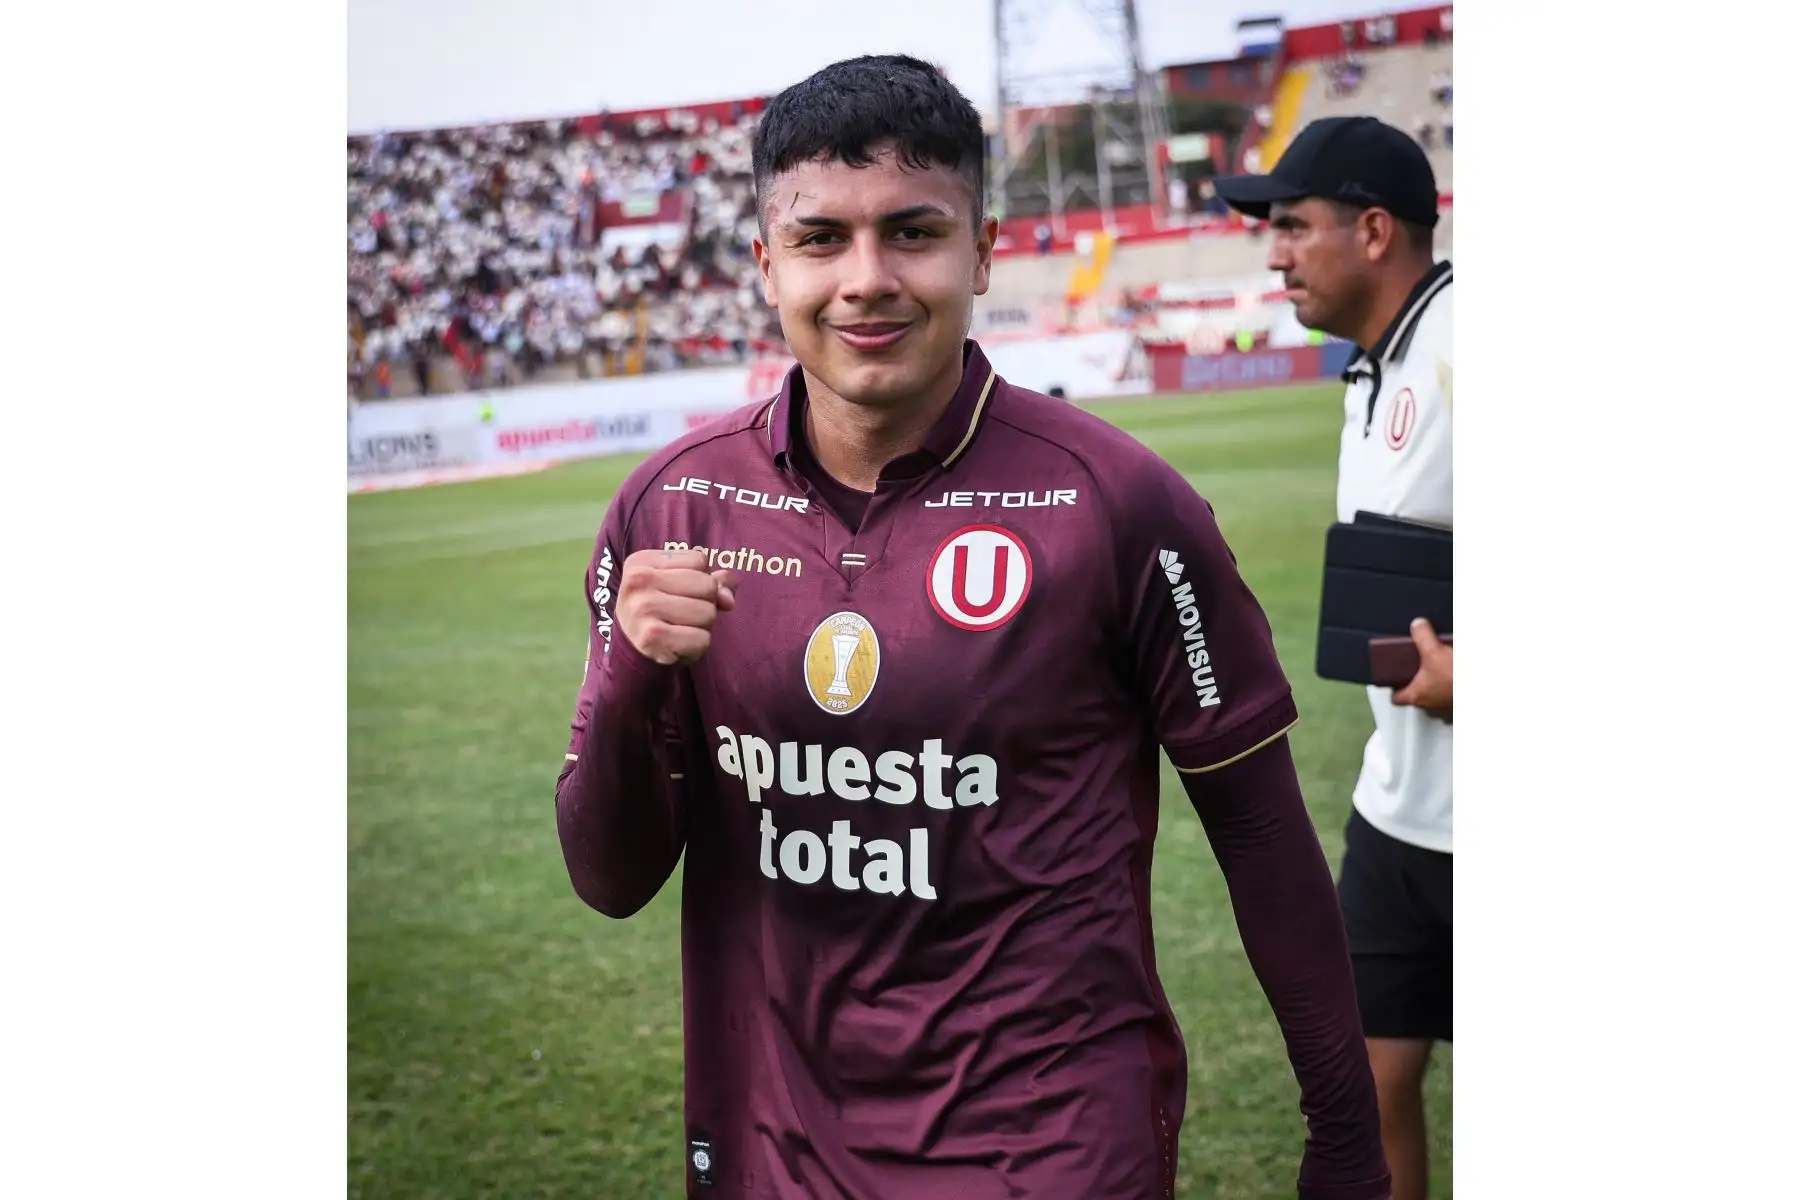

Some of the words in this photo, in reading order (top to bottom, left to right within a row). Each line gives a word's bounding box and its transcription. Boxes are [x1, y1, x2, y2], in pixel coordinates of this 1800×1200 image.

[663, 476, 810, 514] JETOUR
[924, 489, 1077, 508] JETOUR
[951, 545, 1009, 618] U
[1171, 581, 1221, 708] MOVISUN
[715, 725, 1000, 810] apuesta
[759, 808, 938, 900] total
